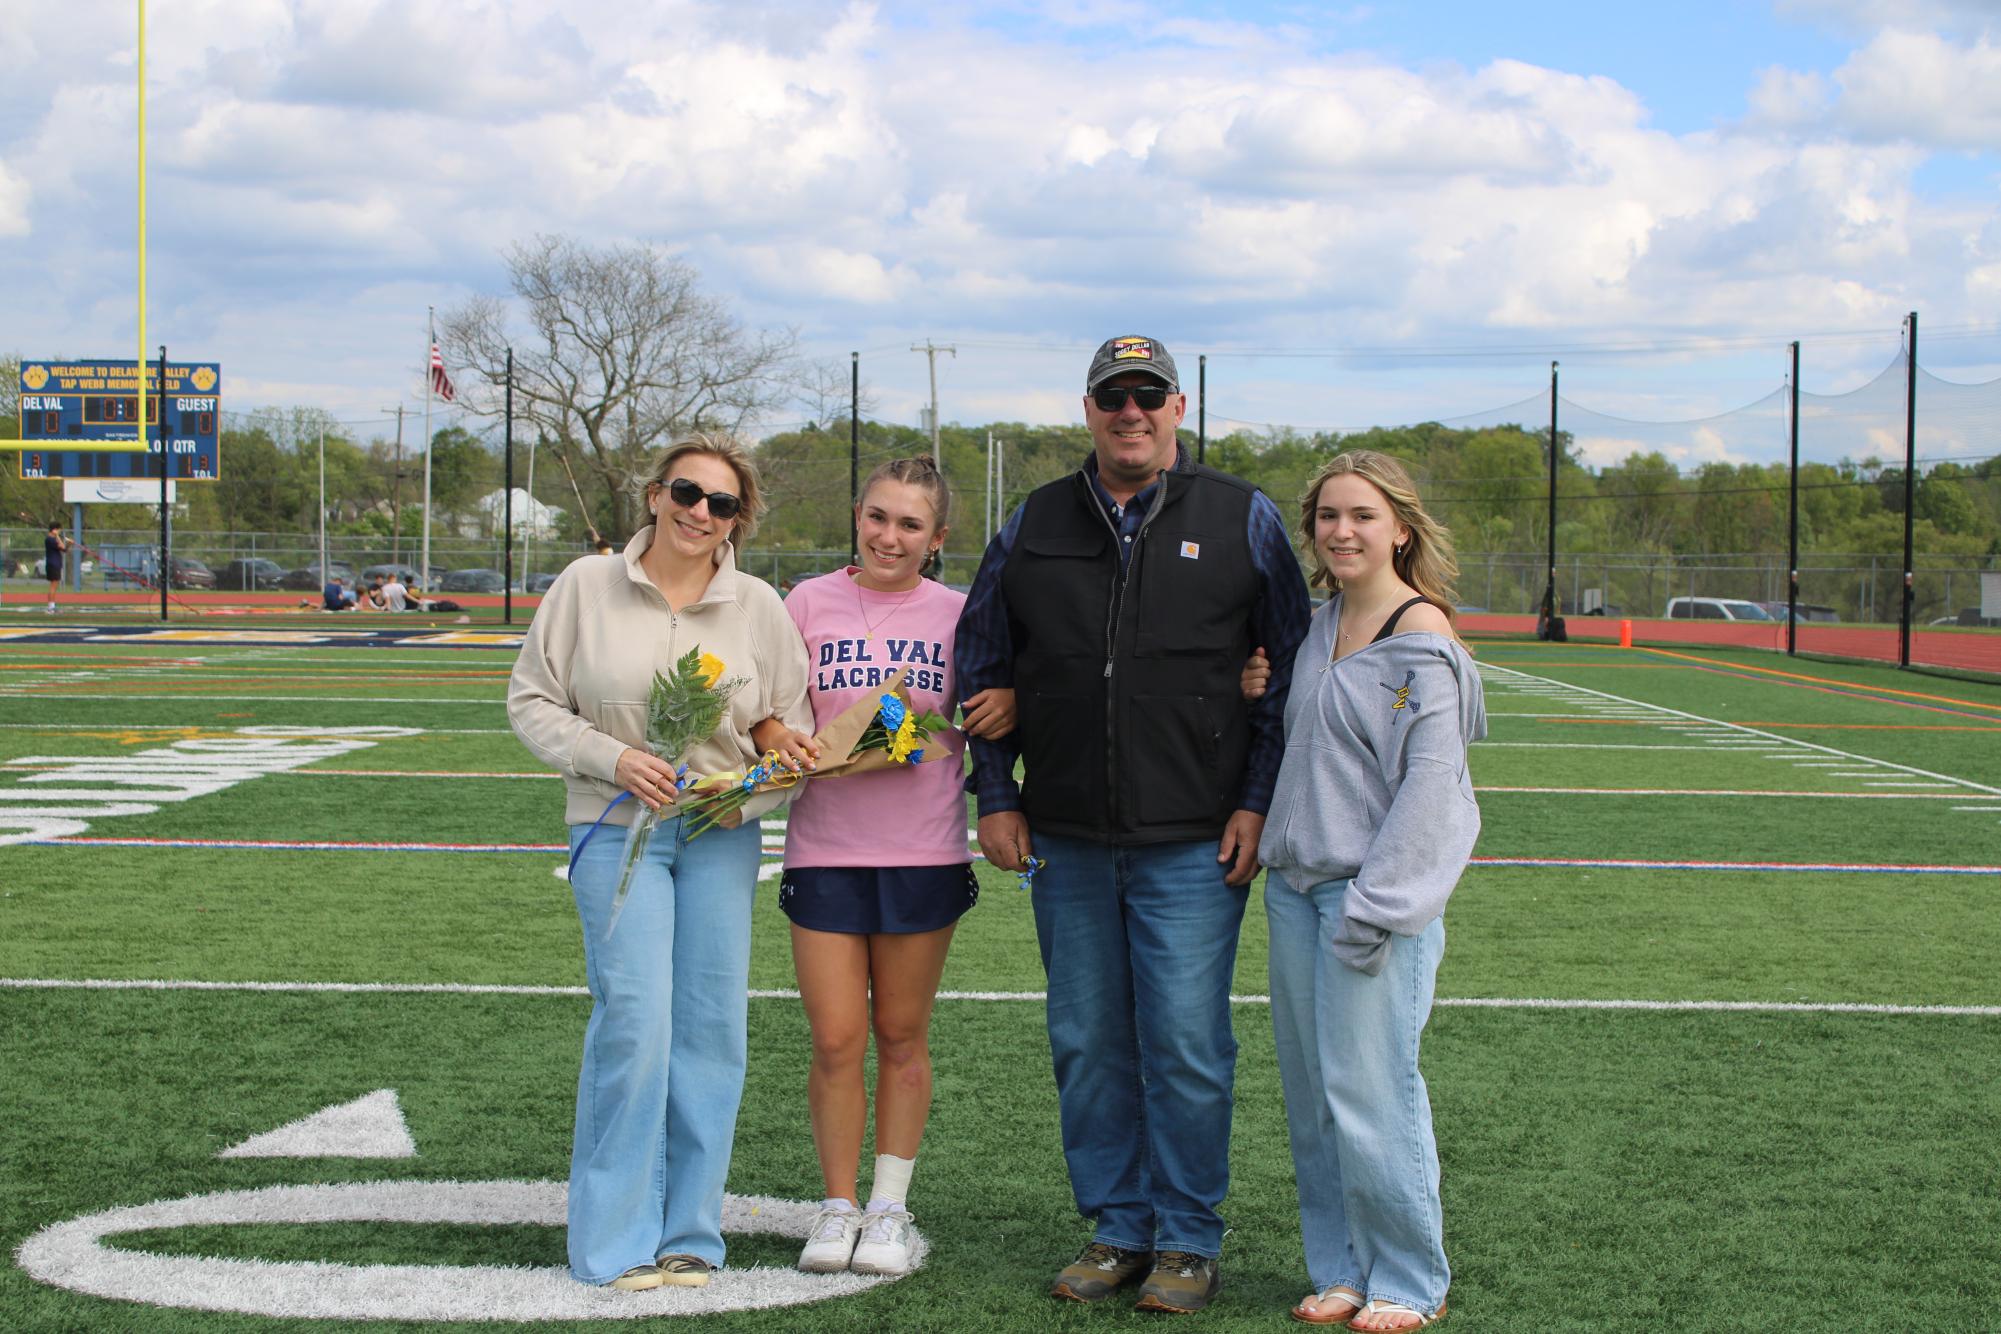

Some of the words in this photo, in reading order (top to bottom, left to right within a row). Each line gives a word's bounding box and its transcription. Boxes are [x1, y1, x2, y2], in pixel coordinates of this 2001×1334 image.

[50, 366, 95, 377] WELCOME
[96, 366, 108, 377] TO
[110, 367, 158, 378] DELAWRE
[159, 367, 190, 379] ALLEY
[60, 379, 77, 389] TAP
[156, 380, 180, 390] FELD
[23, 397, 42, 410] DEL
[44, 397, 63, 410] VAL
[176, 398, 216, 412] GUEST
[173, 440, 196, 453] QTR
[819, 639, 873, 667] DEL
[886, 639, 946, 669] VAL
